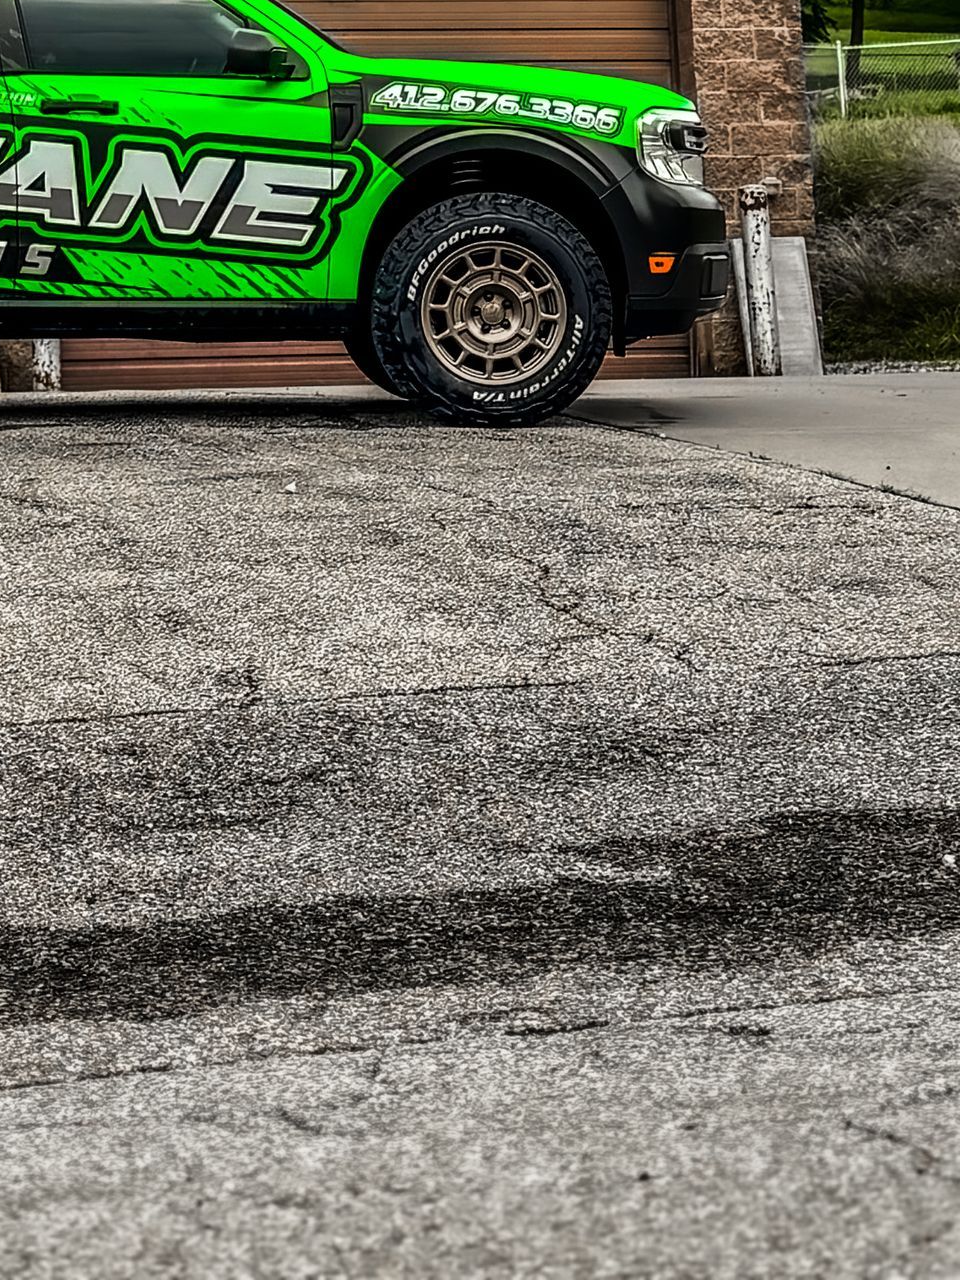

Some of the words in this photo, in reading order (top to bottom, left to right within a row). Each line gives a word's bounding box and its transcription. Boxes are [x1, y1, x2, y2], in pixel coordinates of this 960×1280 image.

[375, 83, 621, 134] 412.676.3366
[407, 224, 505, 302] BFGoodrich
[472, 391, 506, 402] T/A
